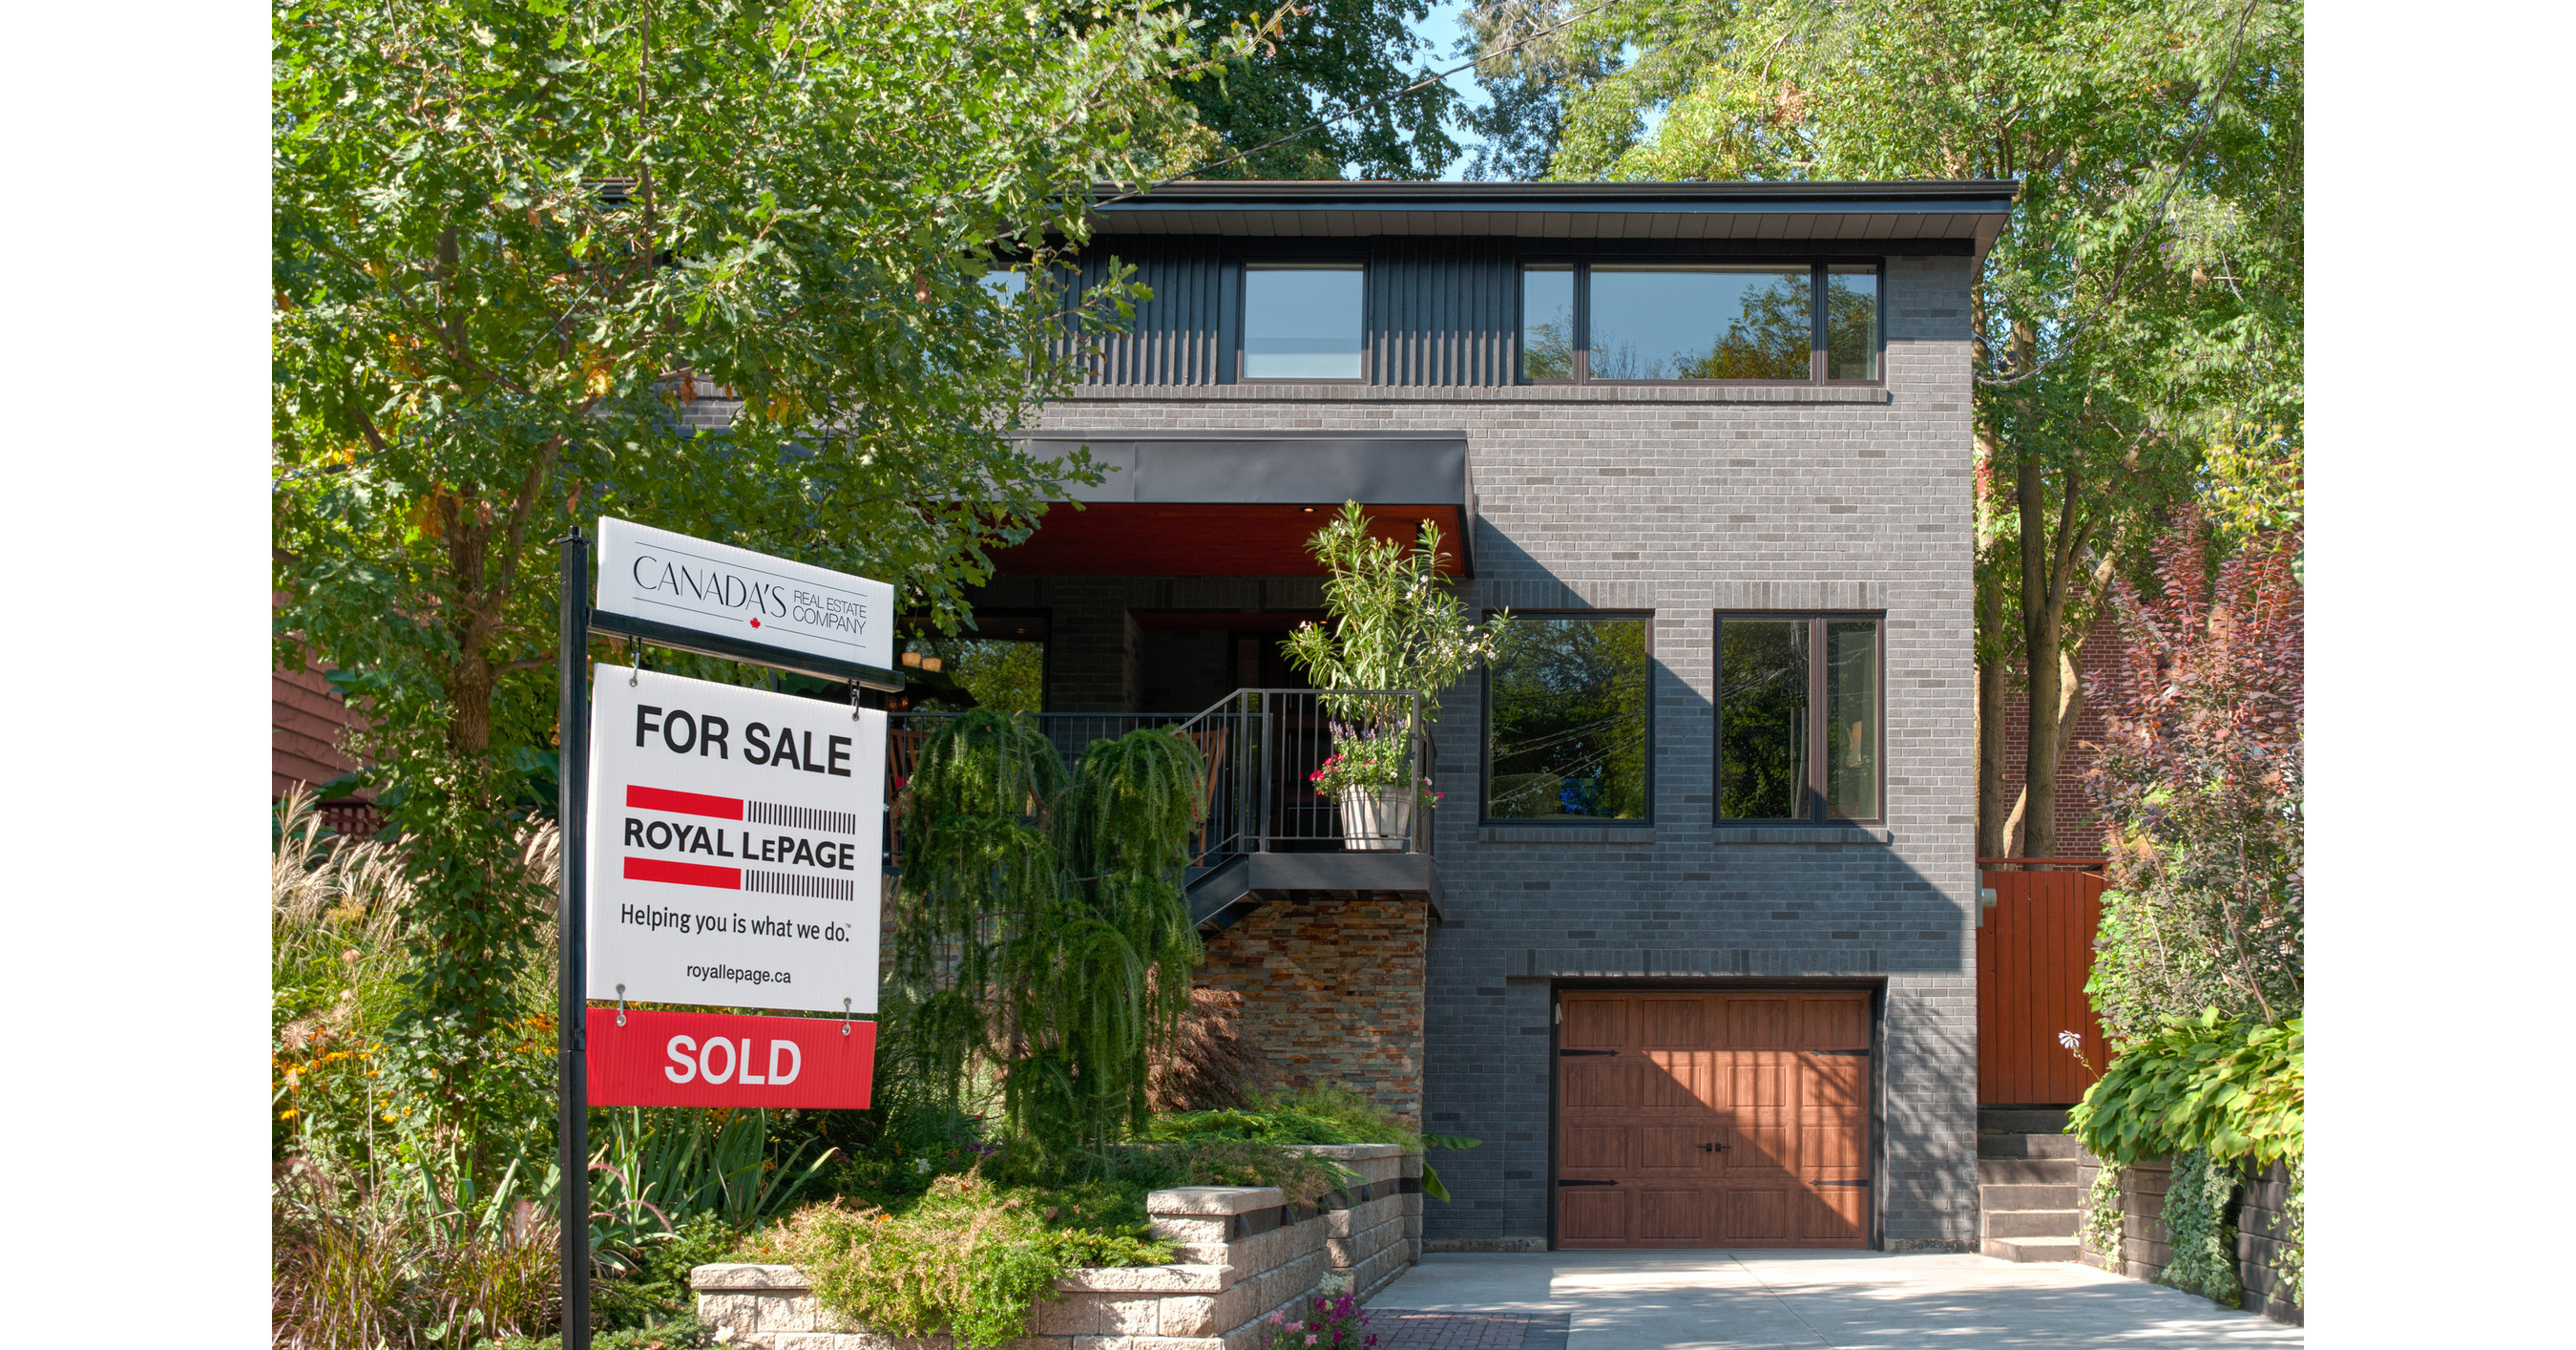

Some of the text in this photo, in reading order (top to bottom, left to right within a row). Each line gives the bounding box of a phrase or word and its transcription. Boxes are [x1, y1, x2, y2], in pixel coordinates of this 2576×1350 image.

[633, 556, 786, 619] CANADA'S
[794, 590, 867, 619] REAL ESTATE
[792, 605, 867, 635] COMPANY
[636, 704, 852, 777] FOR SALE
[624, 817, 734, 858] ROYAL
[621, 903, 691, 933] Helping
[696, 914, 727, 935] you
[732, 914, 746, 933] is
[751, 916, 792, 938] what
[797, 924, 820, 939] we
[686, 964, 792, 985] royallepage.ca
[664, 1035, 802, 1086] SOLD
